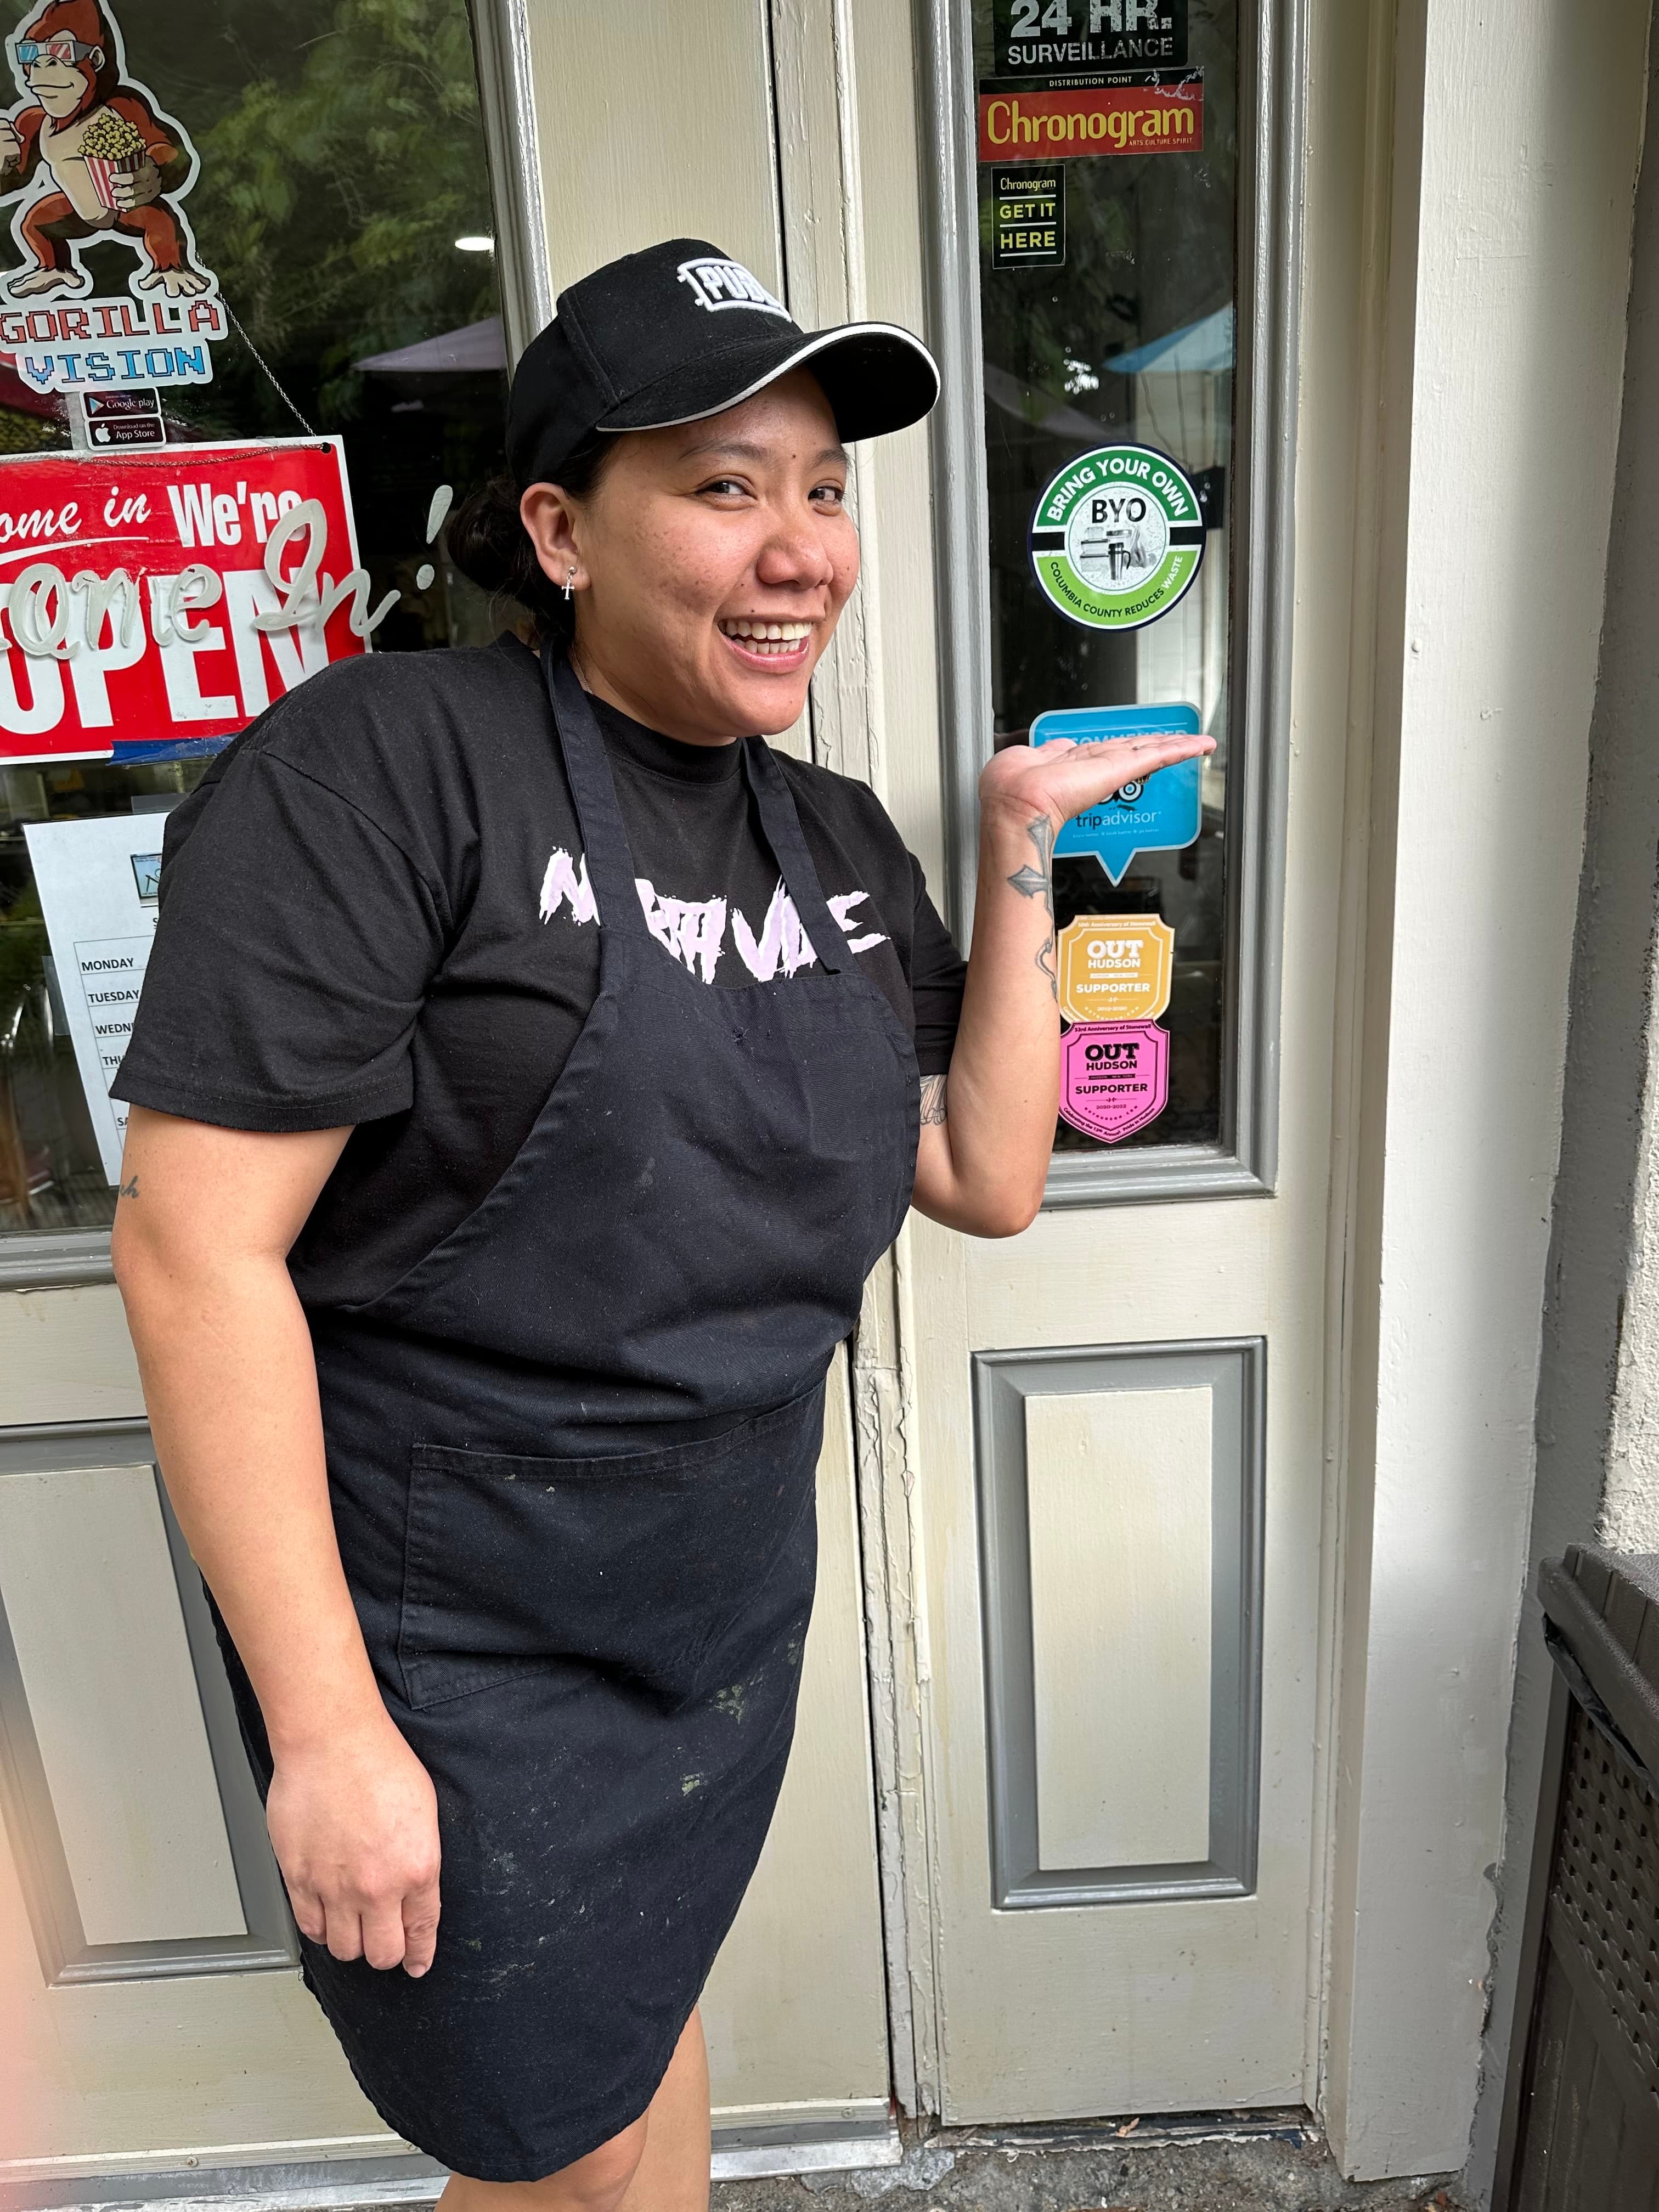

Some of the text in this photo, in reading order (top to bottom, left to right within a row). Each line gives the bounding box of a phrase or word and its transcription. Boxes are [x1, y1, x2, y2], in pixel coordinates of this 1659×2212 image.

[1011, 0, 1173, 38] 24 HR.
[1007, 37, 1173, 65] SURVEILLANCE
[1049, 76, 1132, 87] DISTRIBUTION POINT
[988, 100, 1194, 149] Chronogram
[1000, 178, 1056, 191] Chronogram
[1000, 202, 1056, 219] GET IT
[1001, 231, 1056, 249] HERE
[0, 300, 220, 343] GORILLA
[25, 346, 205, 384] VISION
[106, 398, 154, 411] Google play
[116, 430, 155, 441] App Store
[1047, 458, 1189, 521] BRING YOUR OWN
[0, 501, 82, 543] ome
[104, 486, 151, 528] in
[1092, 498, 1146, 523] BYO
[1051, 555, 1182, 618] COLUMBIA COUNTY REDUCES WASTE
[0, 563, 222, 660] ome
[1075, 810, 1157, 830] tripadvisor
[1087, 940, 1144, 959] OUT
[81, 958, 134, 971] MONDAY
[1088, 958, 1141, 969] HUDSON
[88, 990, 139, 1003] TUESDAY
[1076, 983, 1150, 994] SUPPORTER
[95, 1023, 134, 1035] WEDN
[1085, 1042, 1139, 1061] OUT
[1086, 1060, 1137, 1070] HUDSON
[1075, 1084, 1148, 1094] SUPPORTER
